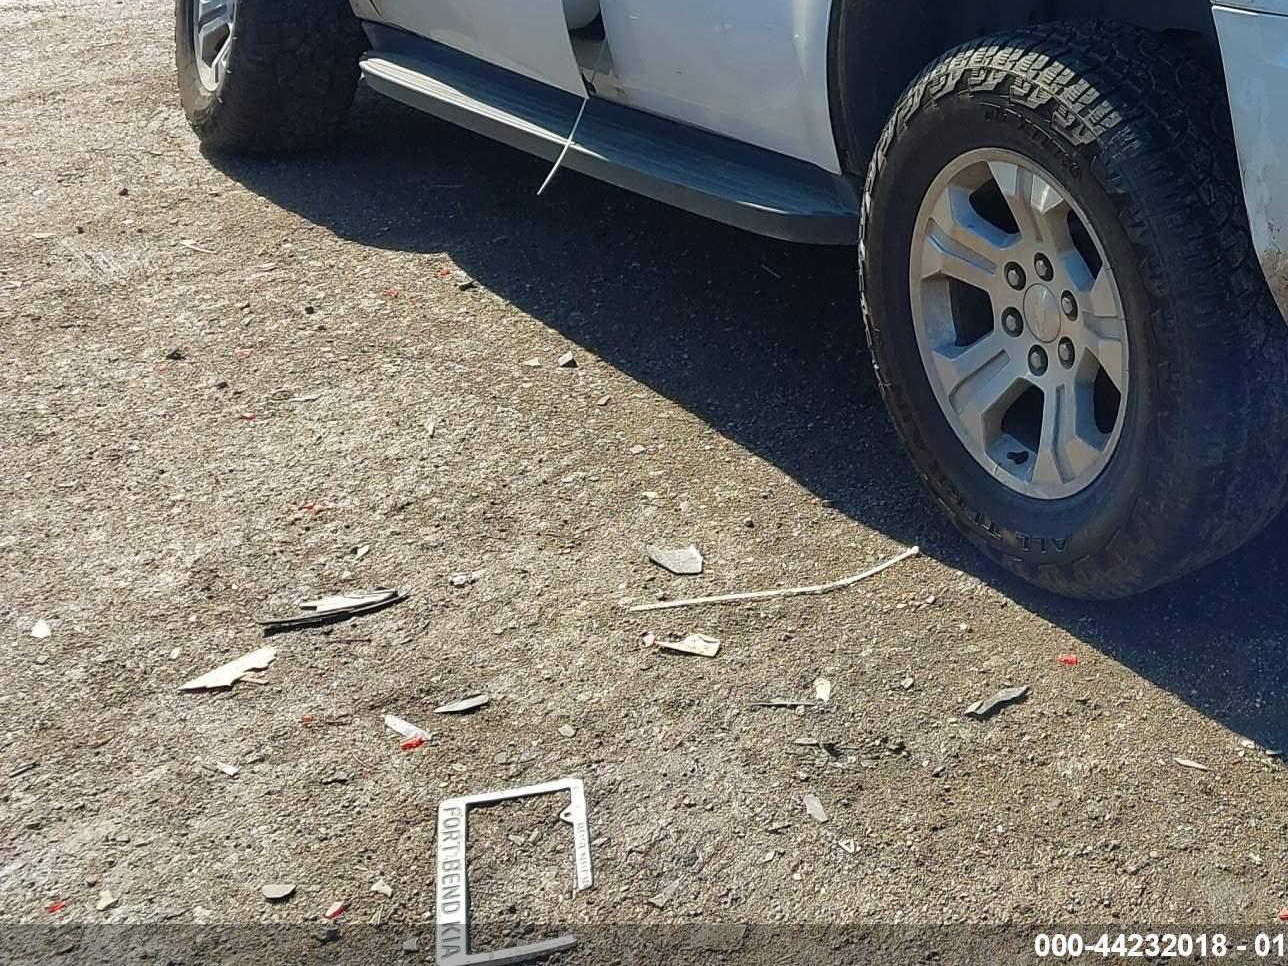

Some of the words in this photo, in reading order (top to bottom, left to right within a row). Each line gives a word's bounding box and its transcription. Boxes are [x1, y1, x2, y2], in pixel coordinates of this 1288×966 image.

[441, 806, 463, 852] FORT
[440, 858, 462, 915] BEND
[440, 921, 462, 960] KIA
